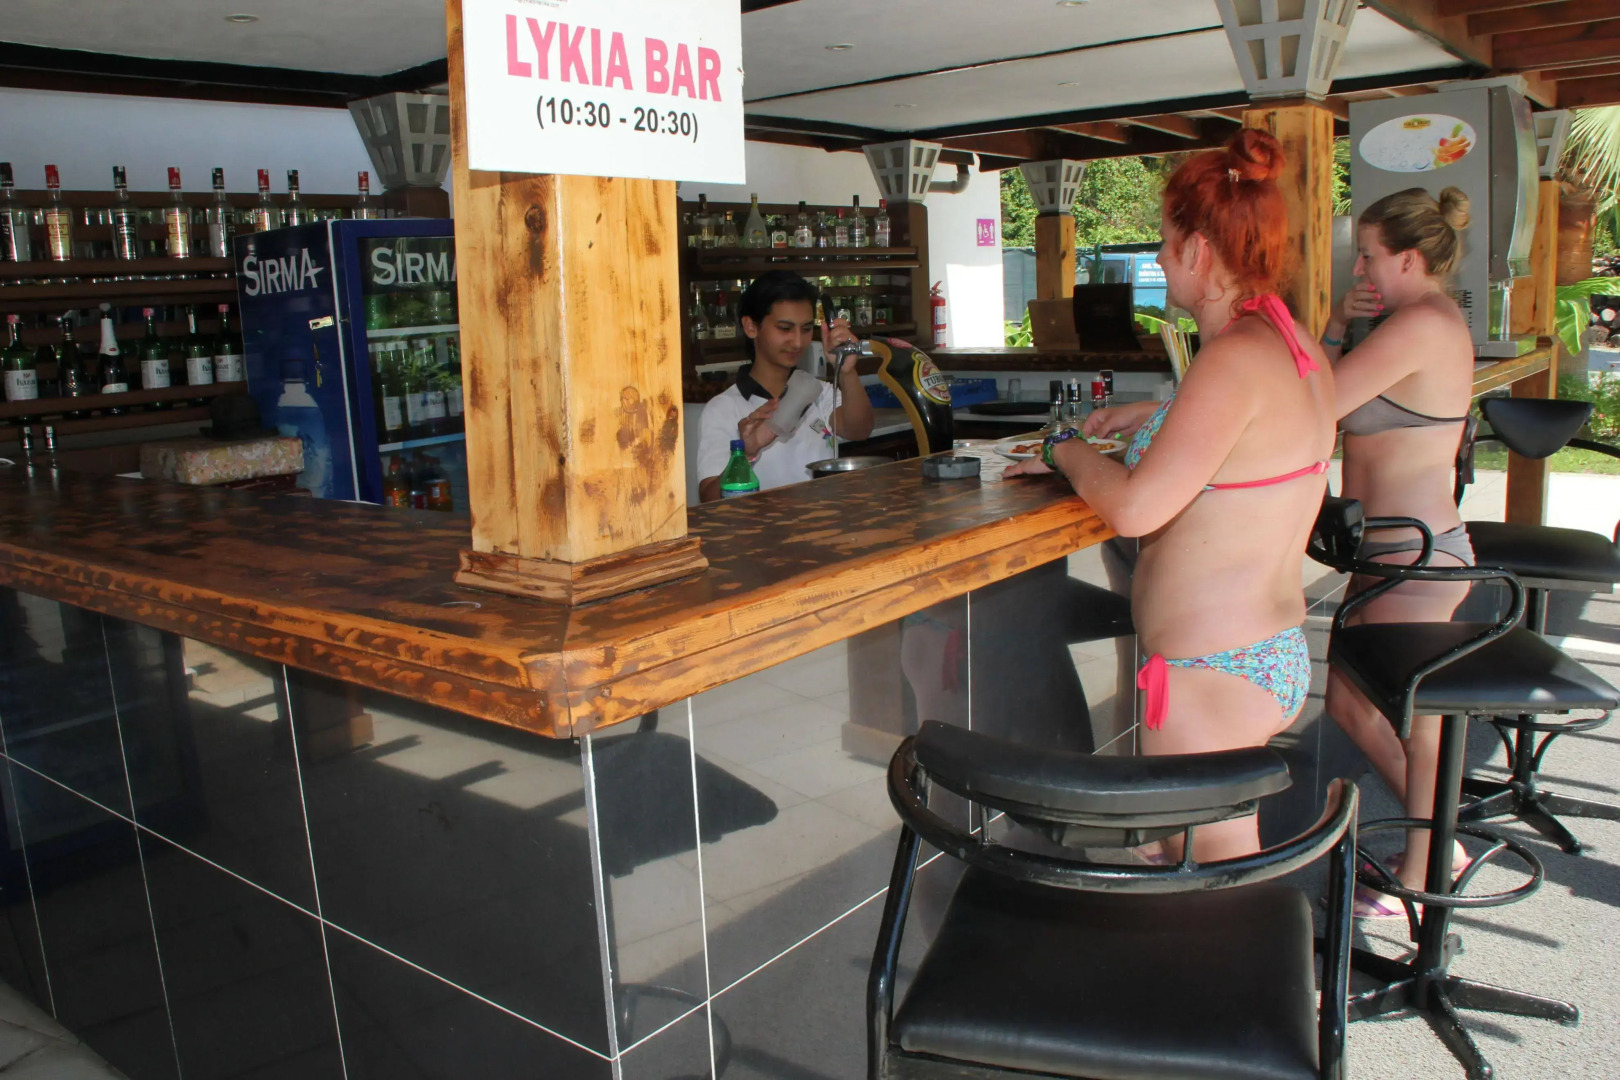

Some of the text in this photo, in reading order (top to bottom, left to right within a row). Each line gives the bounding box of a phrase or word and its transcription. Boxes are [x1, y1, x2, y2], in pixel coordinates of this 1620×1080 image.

[505, 14, 722, 102] LYKIA BAR
[536, 95, 611, 130] (10:30
[633, 106, 699, 143] 20:30)
[243, 247, 324, 296] SIRMA
